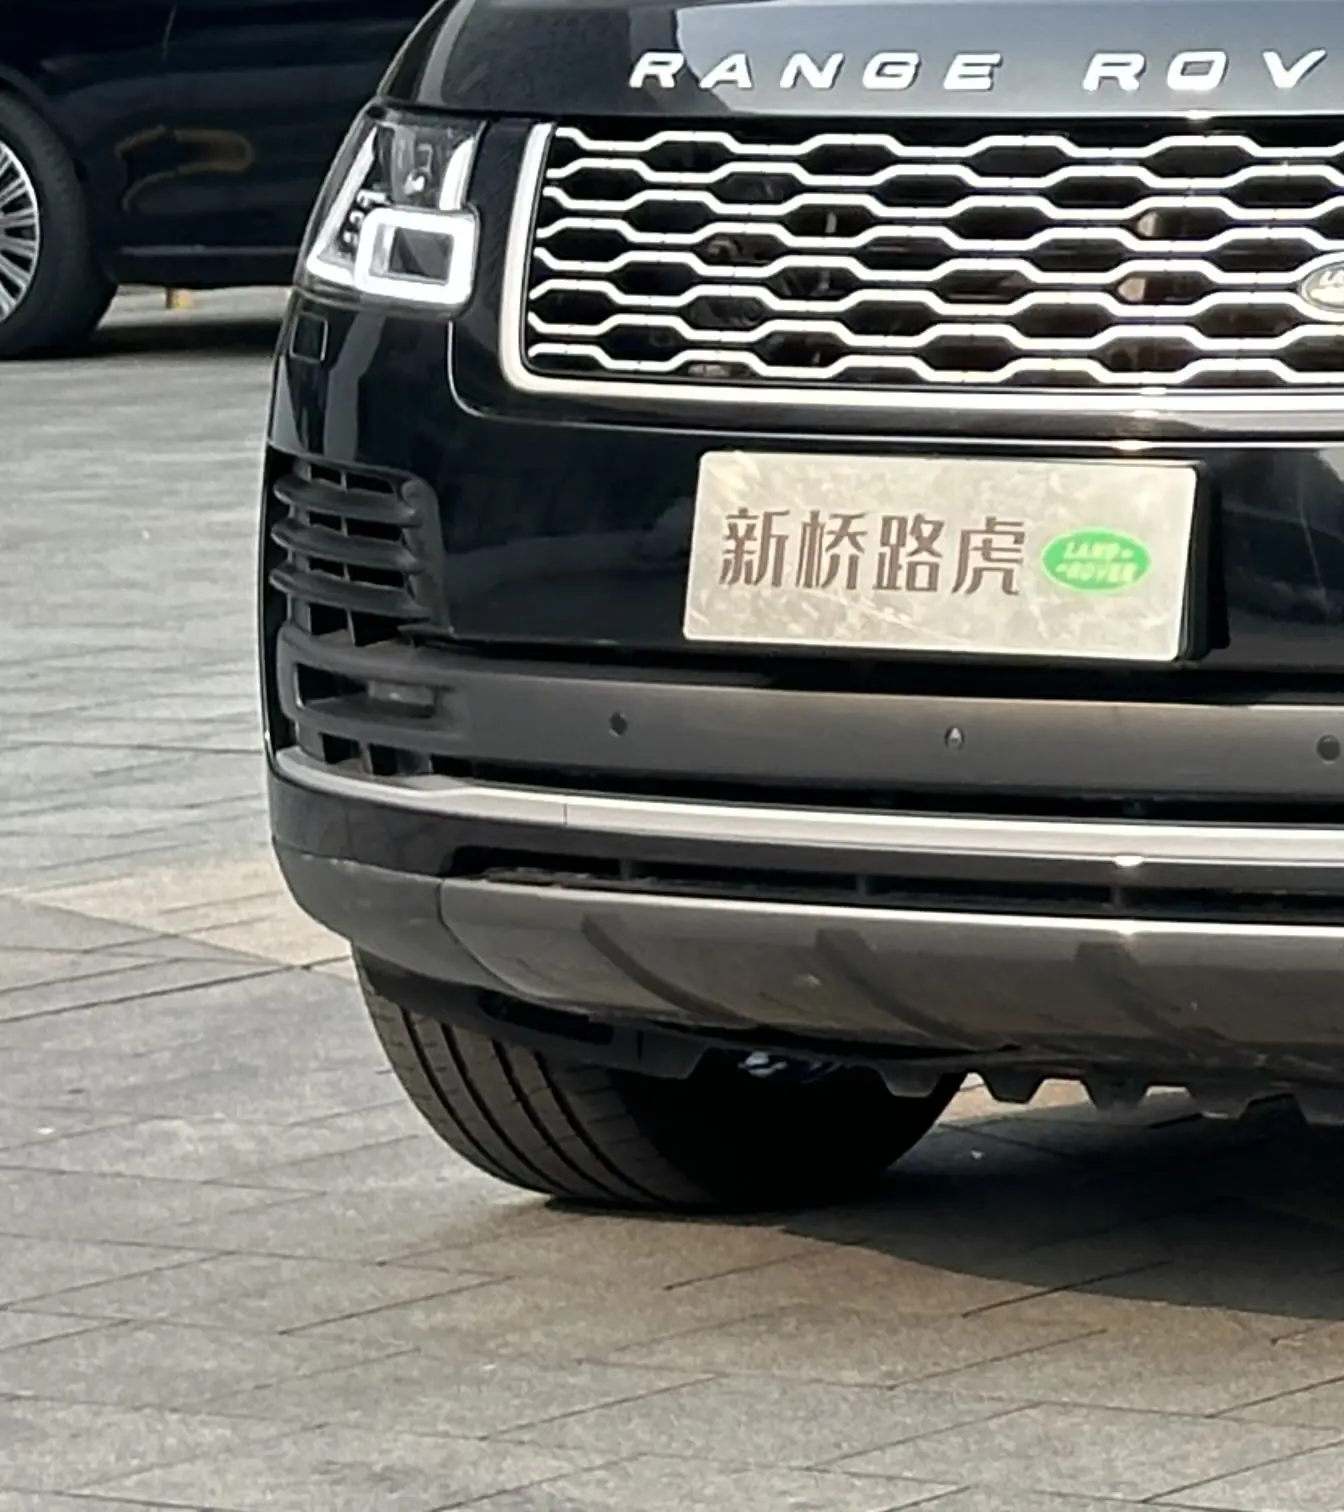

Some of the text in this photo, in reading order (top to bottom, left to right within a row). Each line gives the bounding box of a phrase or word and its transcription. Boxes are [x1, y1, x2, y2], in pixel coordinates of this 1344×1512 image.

[628, 51, 1004, 90] RANGE
[719, 506, 1027, 596] 新桥路虎
